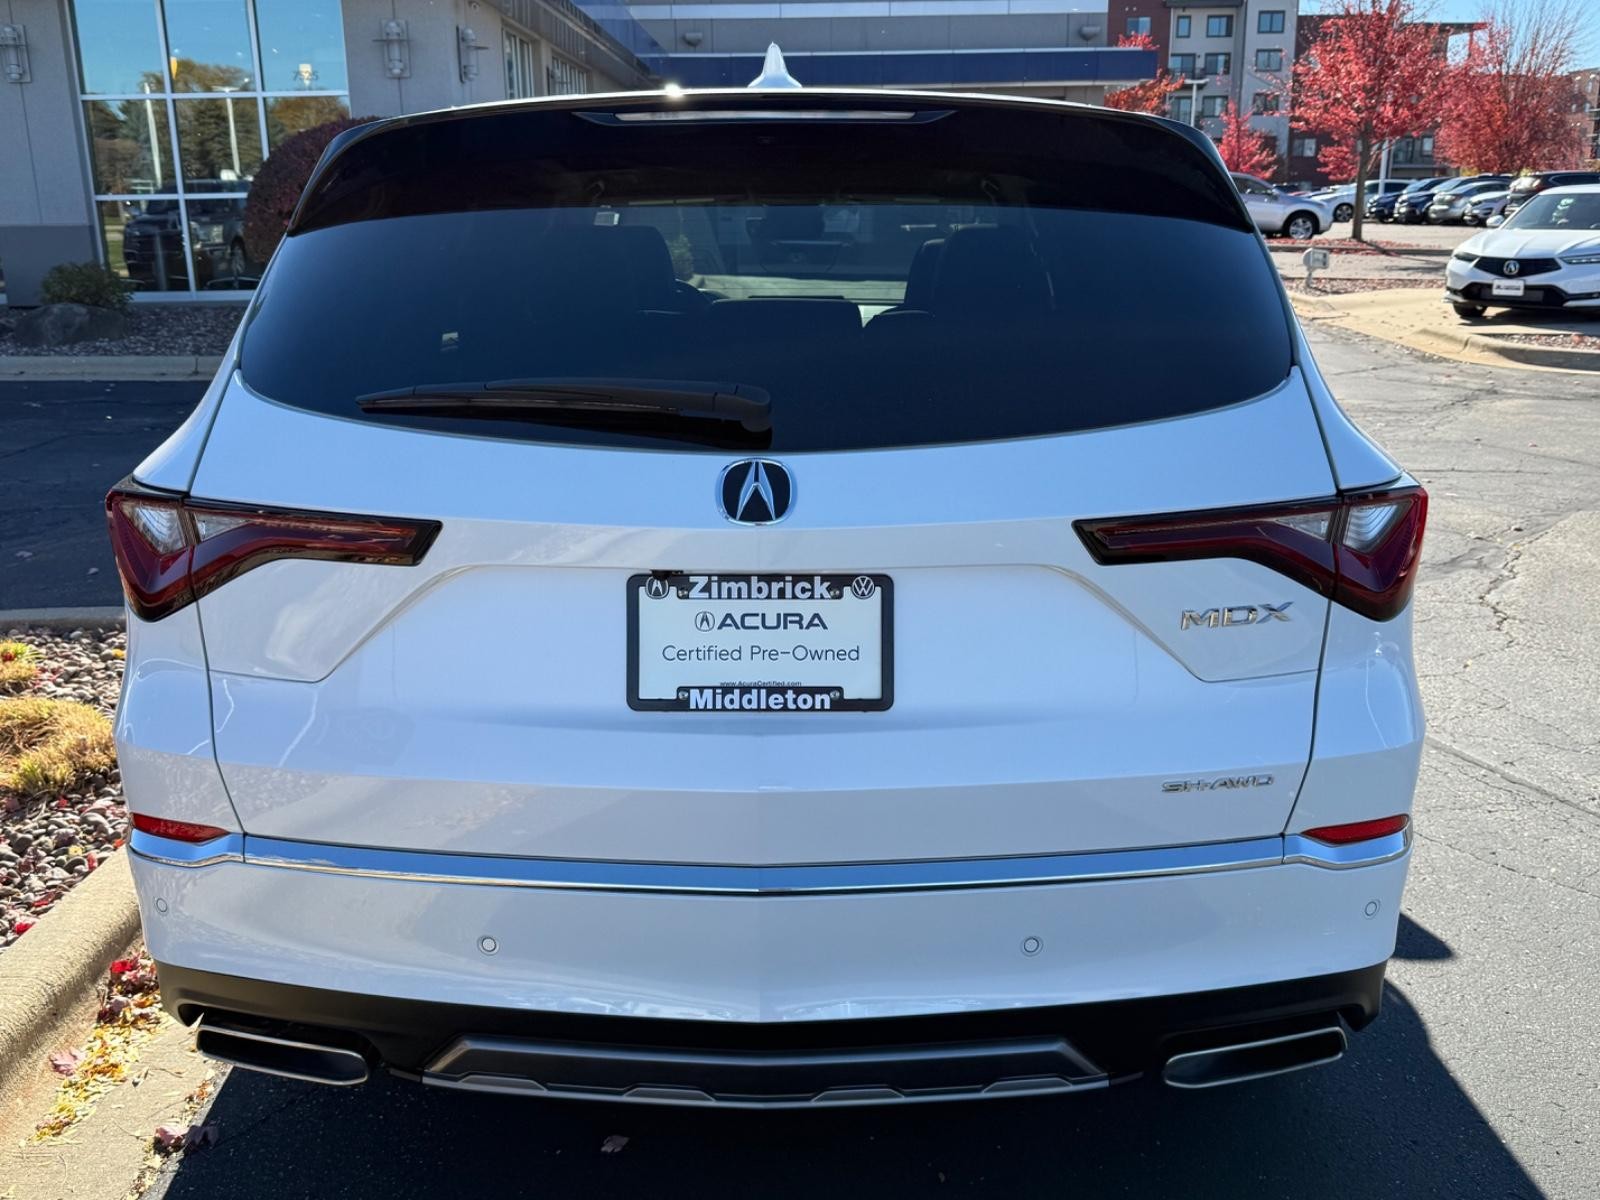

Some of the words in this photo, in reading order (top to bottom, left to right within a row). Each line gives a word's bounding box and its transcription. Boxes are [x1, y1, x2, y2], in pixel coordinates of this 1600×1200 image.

[688, 576, 831, 599] Zimbrick
[717, 613, 828, 630] ACURA
[1181, 601, 1294, 630] MDX
[662, 645, 741, 661] Certified
[750, 645, 859, 661] Pre-Owned
[689, 689, 830, 709] Middleton
[1161, 774, 1275, 792] SH-AWD
